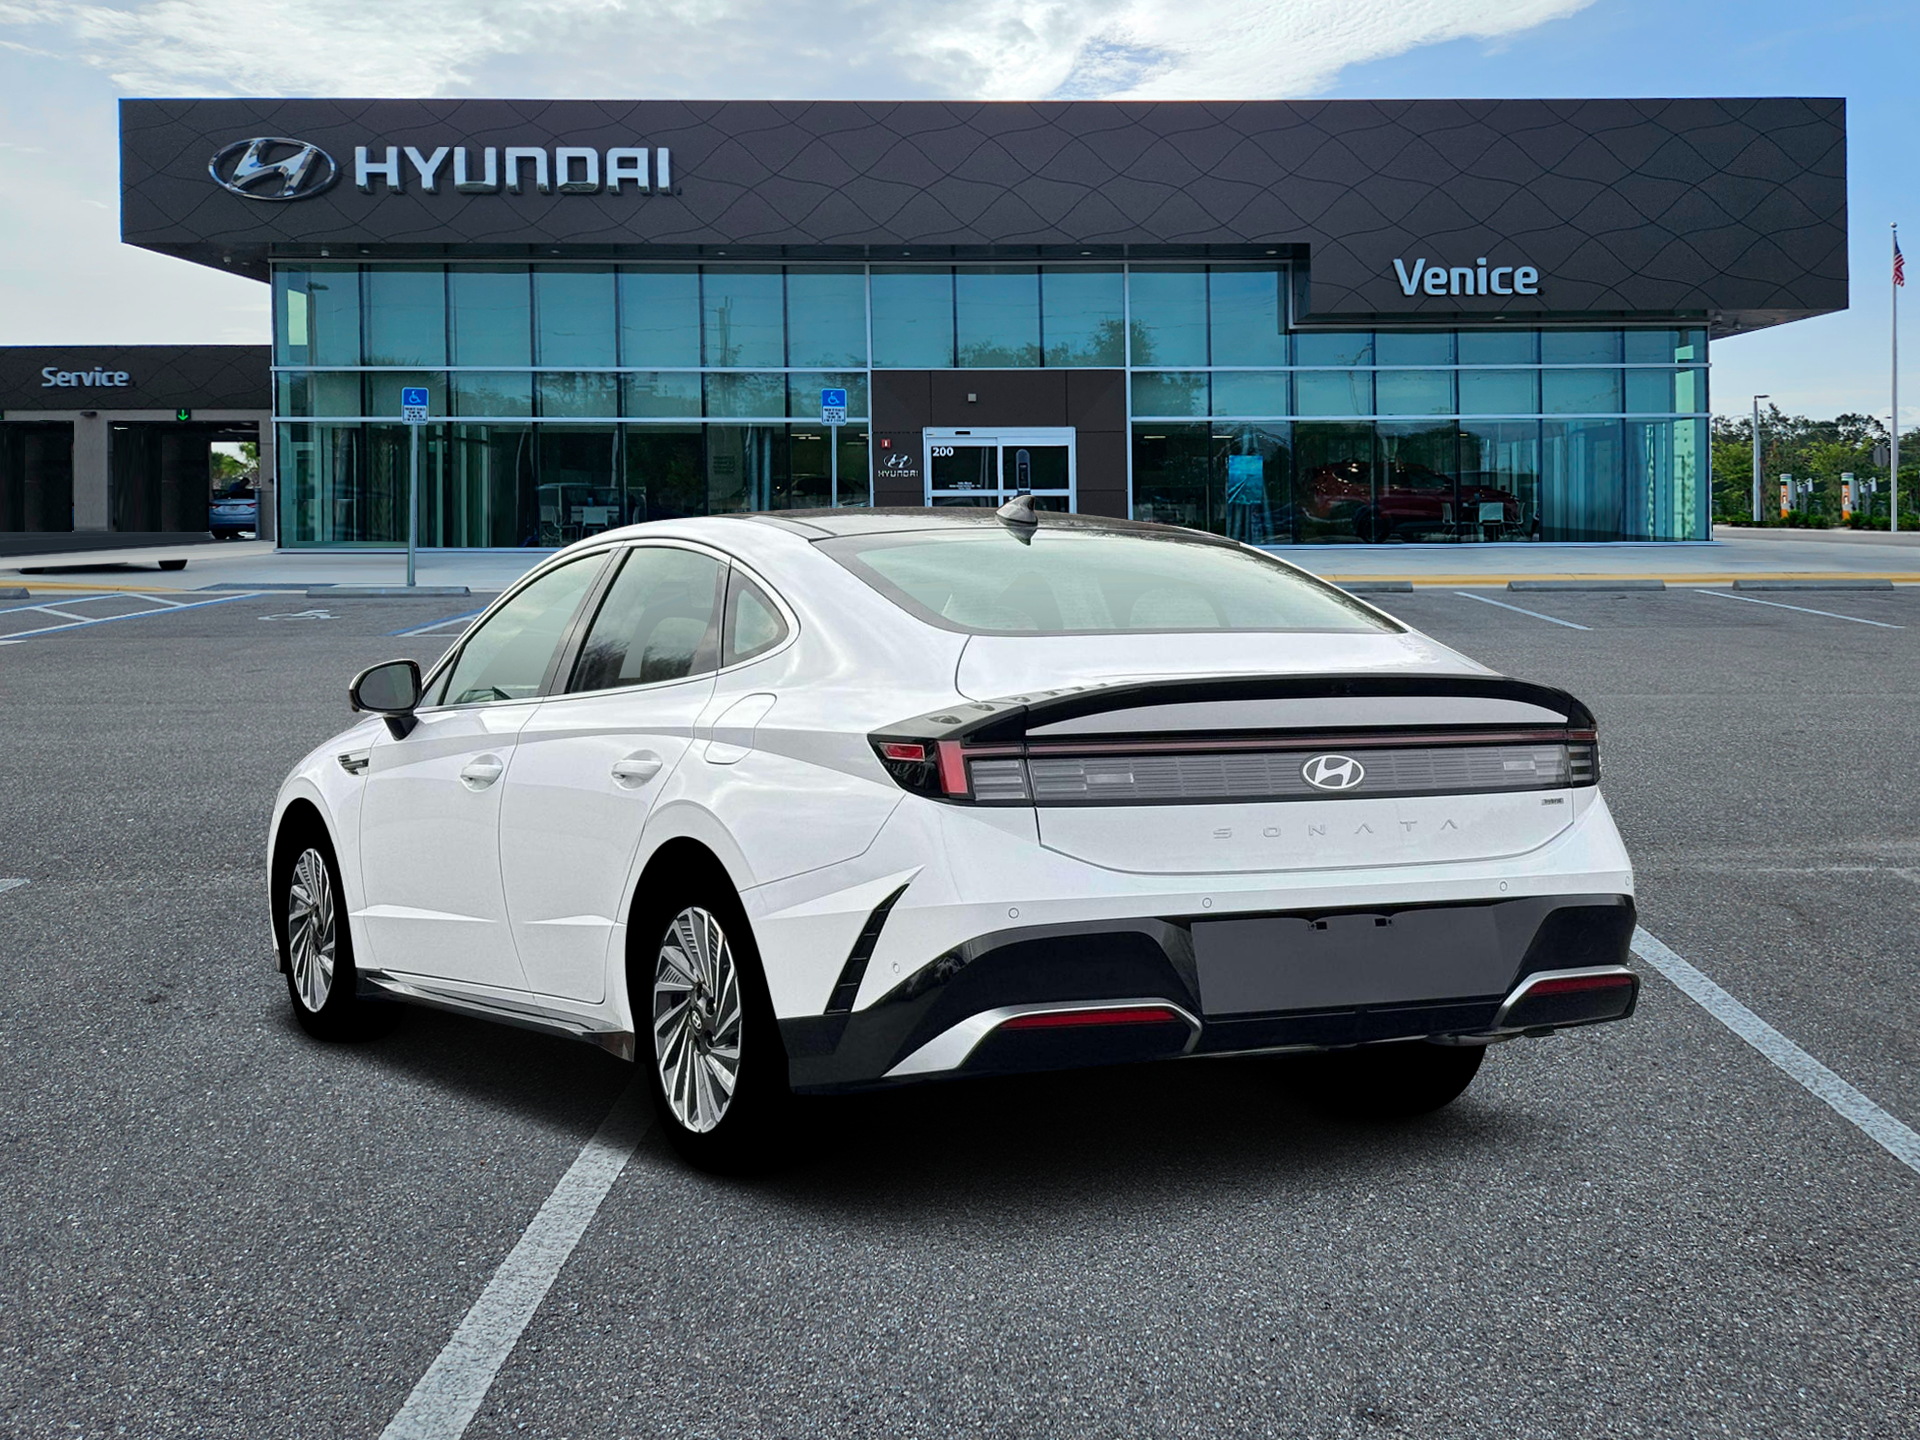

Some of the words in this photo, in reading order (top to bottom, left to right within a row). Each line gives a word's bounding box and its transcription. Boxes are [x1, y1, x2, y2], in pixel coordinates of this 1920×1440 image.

[354, 146, 670, 194] HYUNDAI
[1393, 257, 1539, 296] Venice
[41, 366, 130, 387] Service
[932, 446, 954, 457] 200
[877, 470, 919, 478] HYUNDAI
[1213, 818, 1459, 840] SONATA
